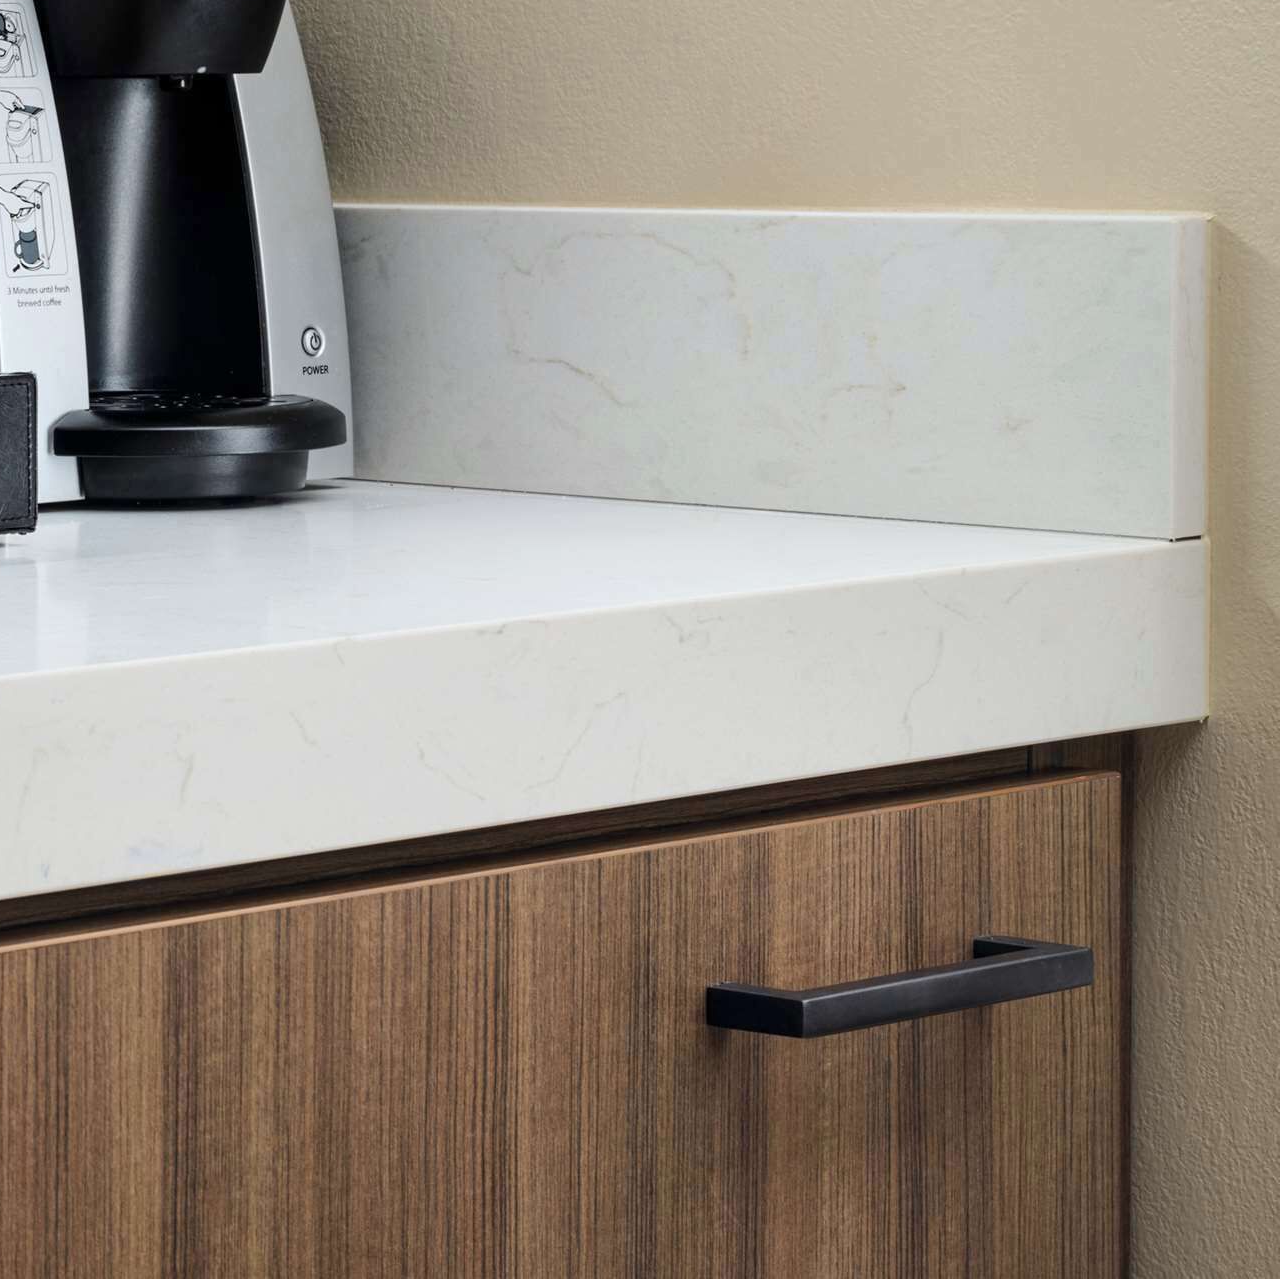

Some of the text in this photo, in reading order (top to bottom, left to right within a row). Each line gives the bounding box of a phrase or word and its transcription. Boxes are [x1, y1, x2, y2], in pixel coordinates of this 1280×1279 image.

[12, 286, 38, 295] Minutes
[39, 285, 54, 294] until
[54, 285, 70, 293] fresh
[17, 298, 62, 308] brewed coffee
[302, 365, 329, 376] POWER
